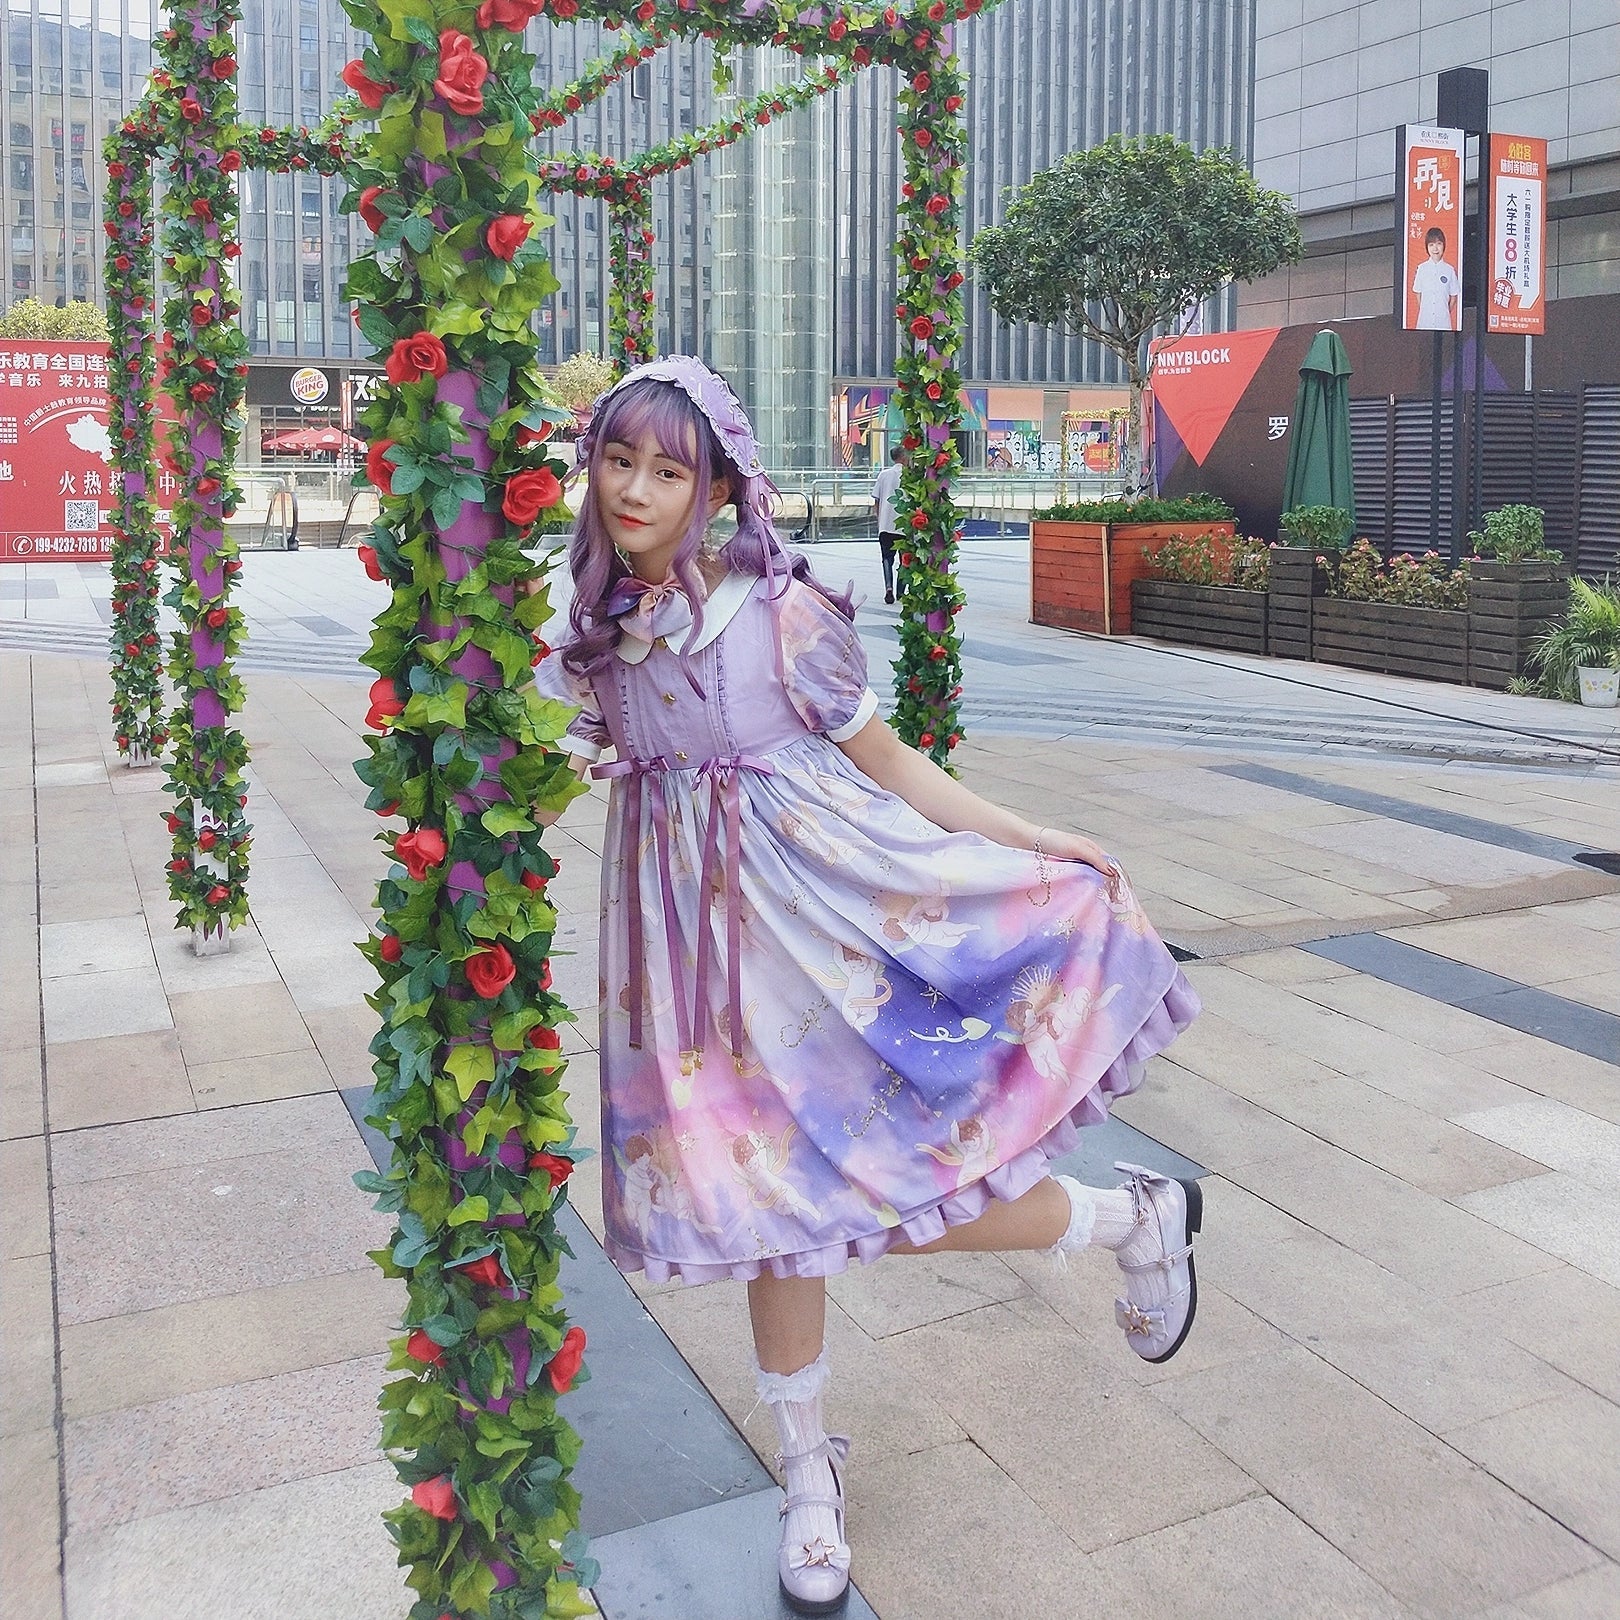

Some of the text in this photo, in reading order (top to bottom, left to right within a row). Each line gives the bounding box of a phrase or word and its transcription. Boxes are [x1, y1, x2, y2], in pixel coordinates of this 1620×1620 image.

[1505, 192, 1518, 280] 大学生8折
[0, 352, 110, 372] 乐教育全国连
[1150, 348, 1231, 367] NNYBLOCK
[295, 375, 324, 396] BURGER KING
[1267, 416, 1289, 441] 罗
